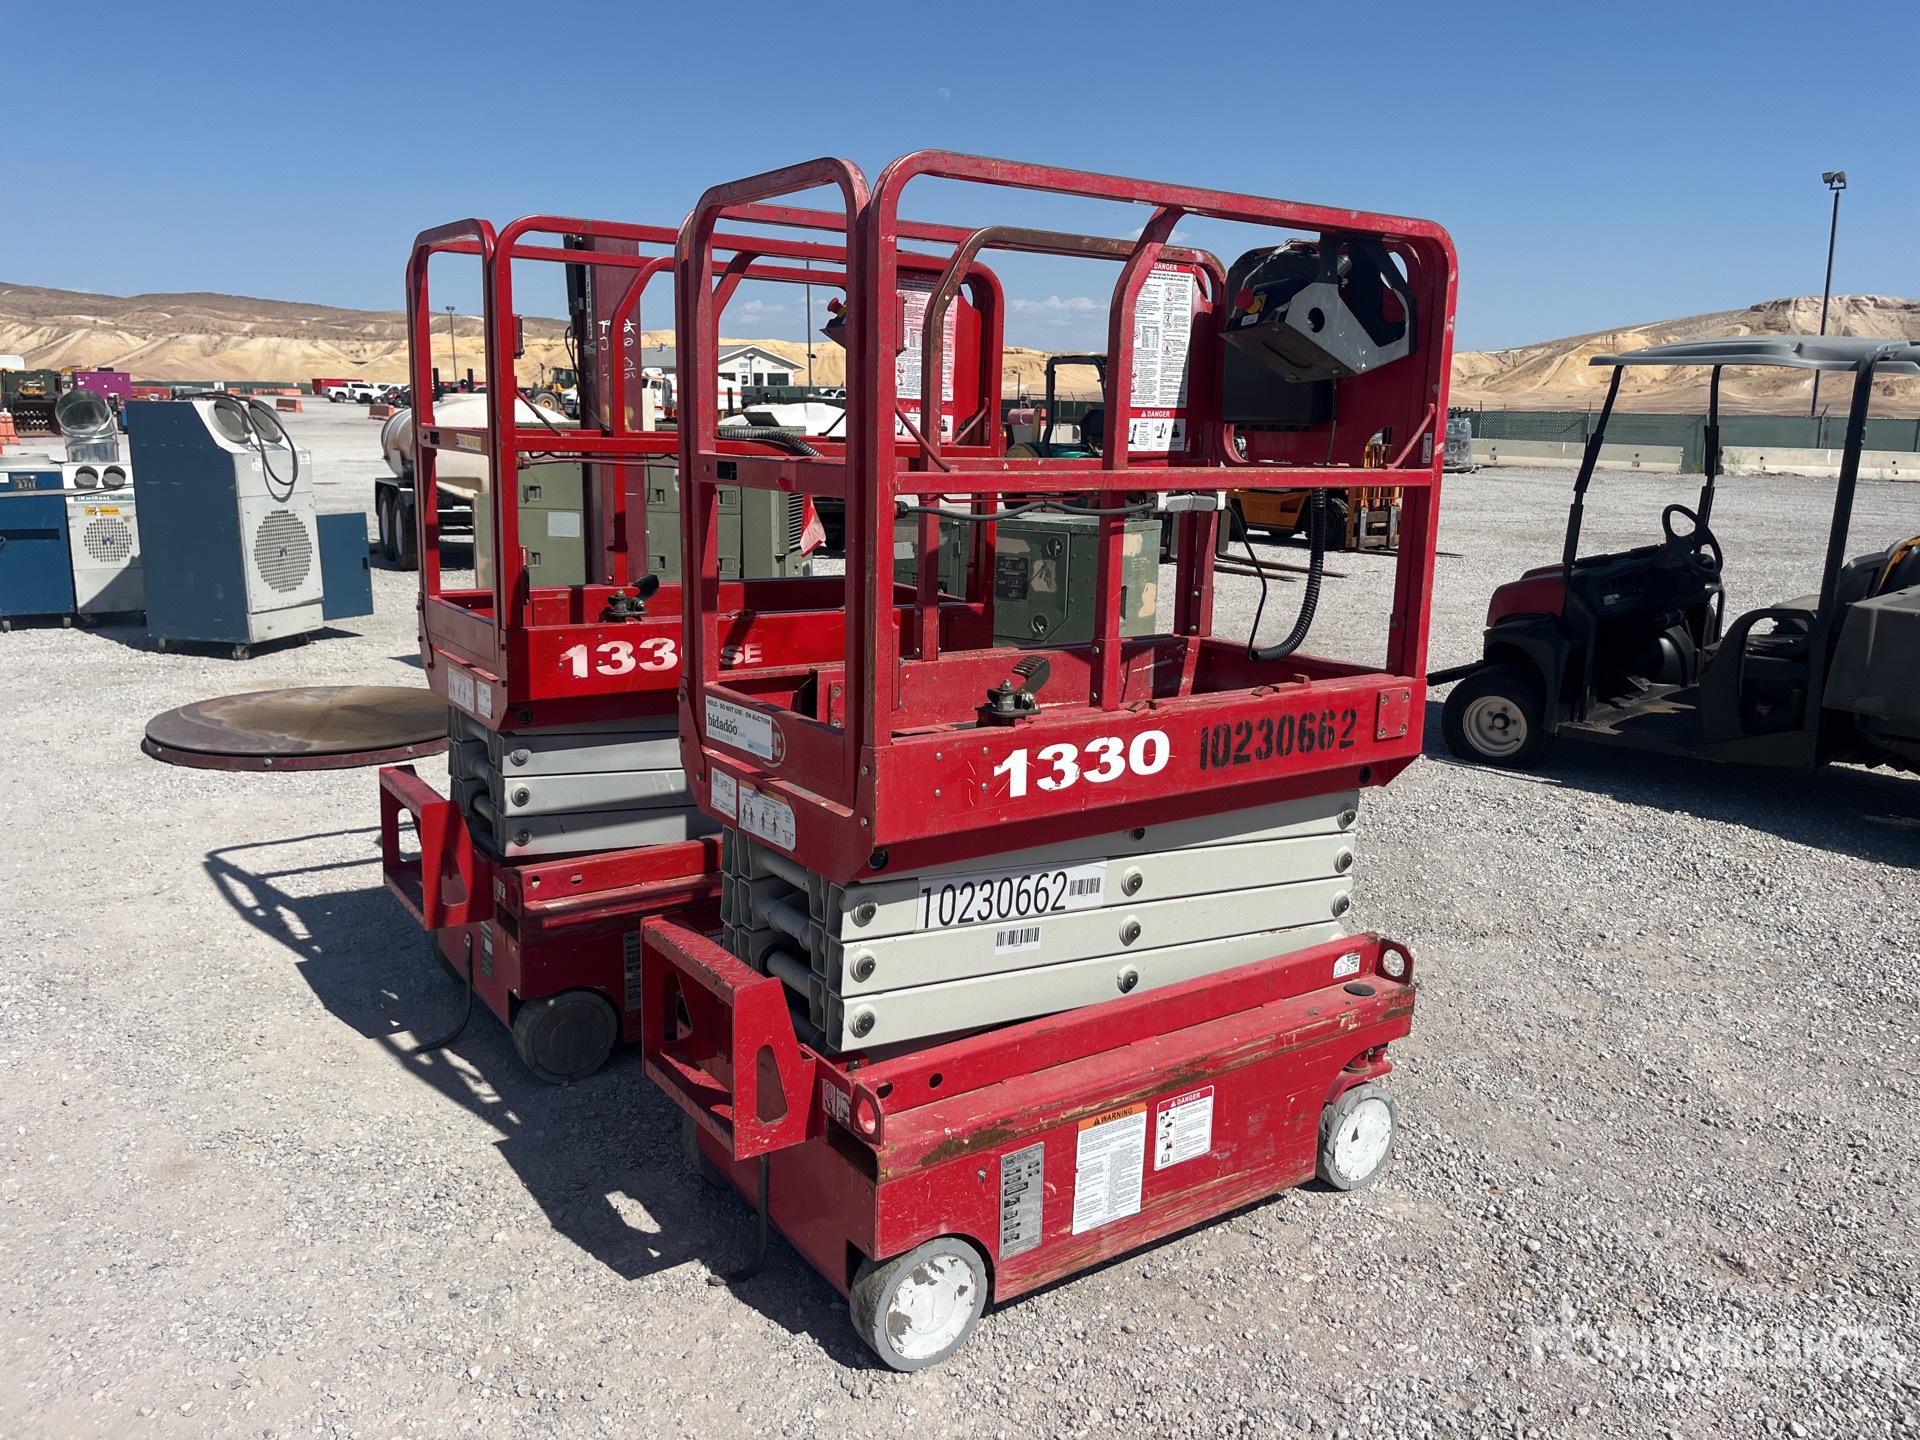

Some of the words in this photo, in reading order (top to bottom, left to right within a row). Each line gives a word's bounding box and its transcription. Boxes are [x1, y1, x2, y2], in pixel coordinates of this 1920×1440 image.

[1153, 262, 1178, 271] DANGER
[1147, 410, 1171, 418] DANGER
[560, 637, 682, 679] 133
[719, 642, 763, 665] SE
[707, 699, 718, 708] HOLD
[752, 714, 771, 726] AUCTION
[708, 713, 738, 736] bidadoo
[993, 730, 1171, 798] 1330
[1199, 708, 1357, 771] 10230662
[921, 871, 1068, 929] 10230662
[1176, 1092, 1201, 1106] DANGER
[1100, 1107, 1133, 1124] WARNING
